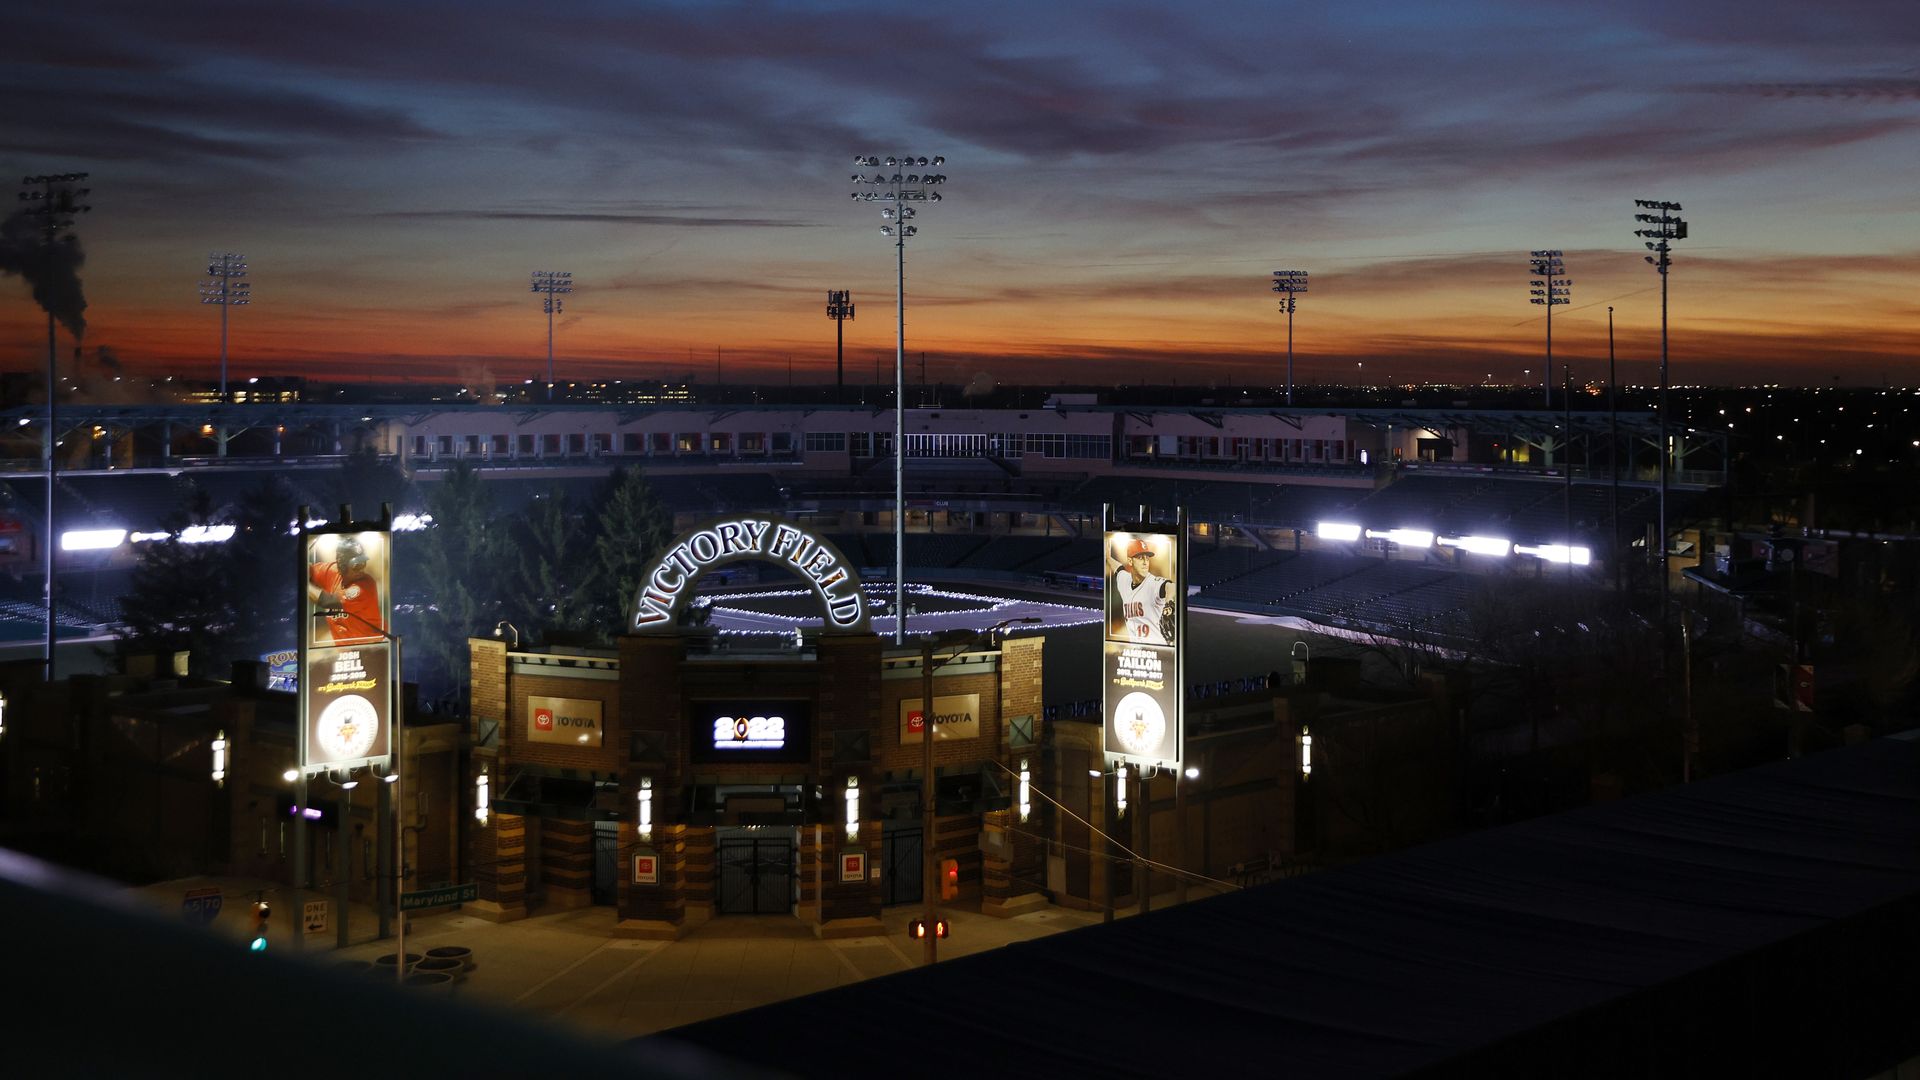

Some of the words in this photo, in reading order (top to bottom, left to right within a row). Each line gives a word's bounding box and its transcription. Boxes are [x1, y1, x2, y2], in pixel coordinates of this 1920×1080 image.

[635, 519, 770, 628] VICTORY
[771, 523, 861, 626] FIELD
[1137, 623, 1150, 638] 19
[338, 651, 360, 660] JOSH
[334, 659, 364, 673] BELL
[1118, 656, 1162, 671] TAILLON
[556, 716, 596, 729] TOYOTA
[932, 712, 972, 724] OYOTA
[714, 716, 785, 740] 2022
[205, 898, 221, 909] 70
[403, 891, 458, 907] Maryland
[464, 888, 475, 897] St
[305, 902, 325, 913] ONE
[305, 913, 326, 922] WAY
